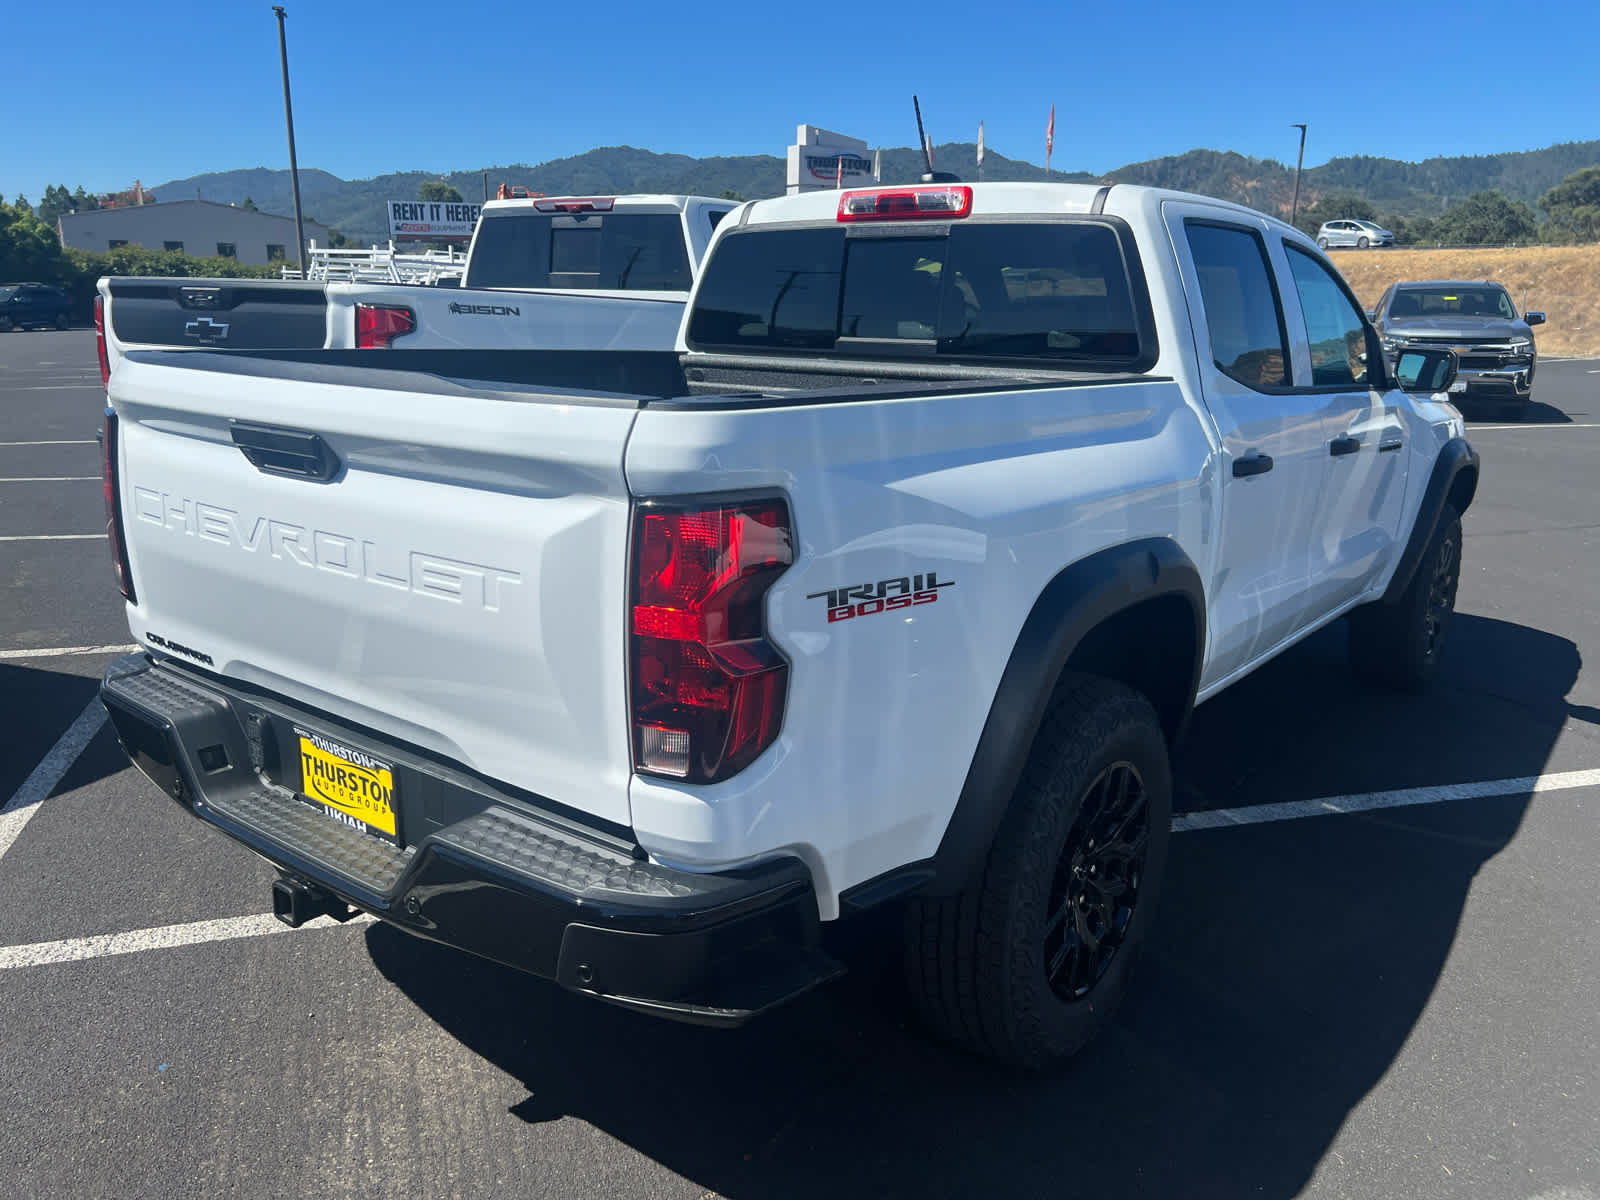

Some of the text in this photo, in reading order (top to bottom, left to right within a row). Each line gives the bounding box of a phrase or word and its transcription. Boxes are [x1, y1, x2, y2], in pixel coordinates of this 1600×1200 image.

[392, 203, 425, 221] RENT
[430, 203, 442, 221] IT
[457, 303, 521, 317] BISON
[134, 485, 522, 613] CHEVROLET
[806, 572, 956, 609] TRAIL
[827, 589, 938, 623] BOSS
[145, 631, 215, 667] COLORADO
[312, 735, 371, 768] THURSTON
[302, 751, 393, 813] THURSTON
[316, 777, 386, 814] AUTO GROUP
